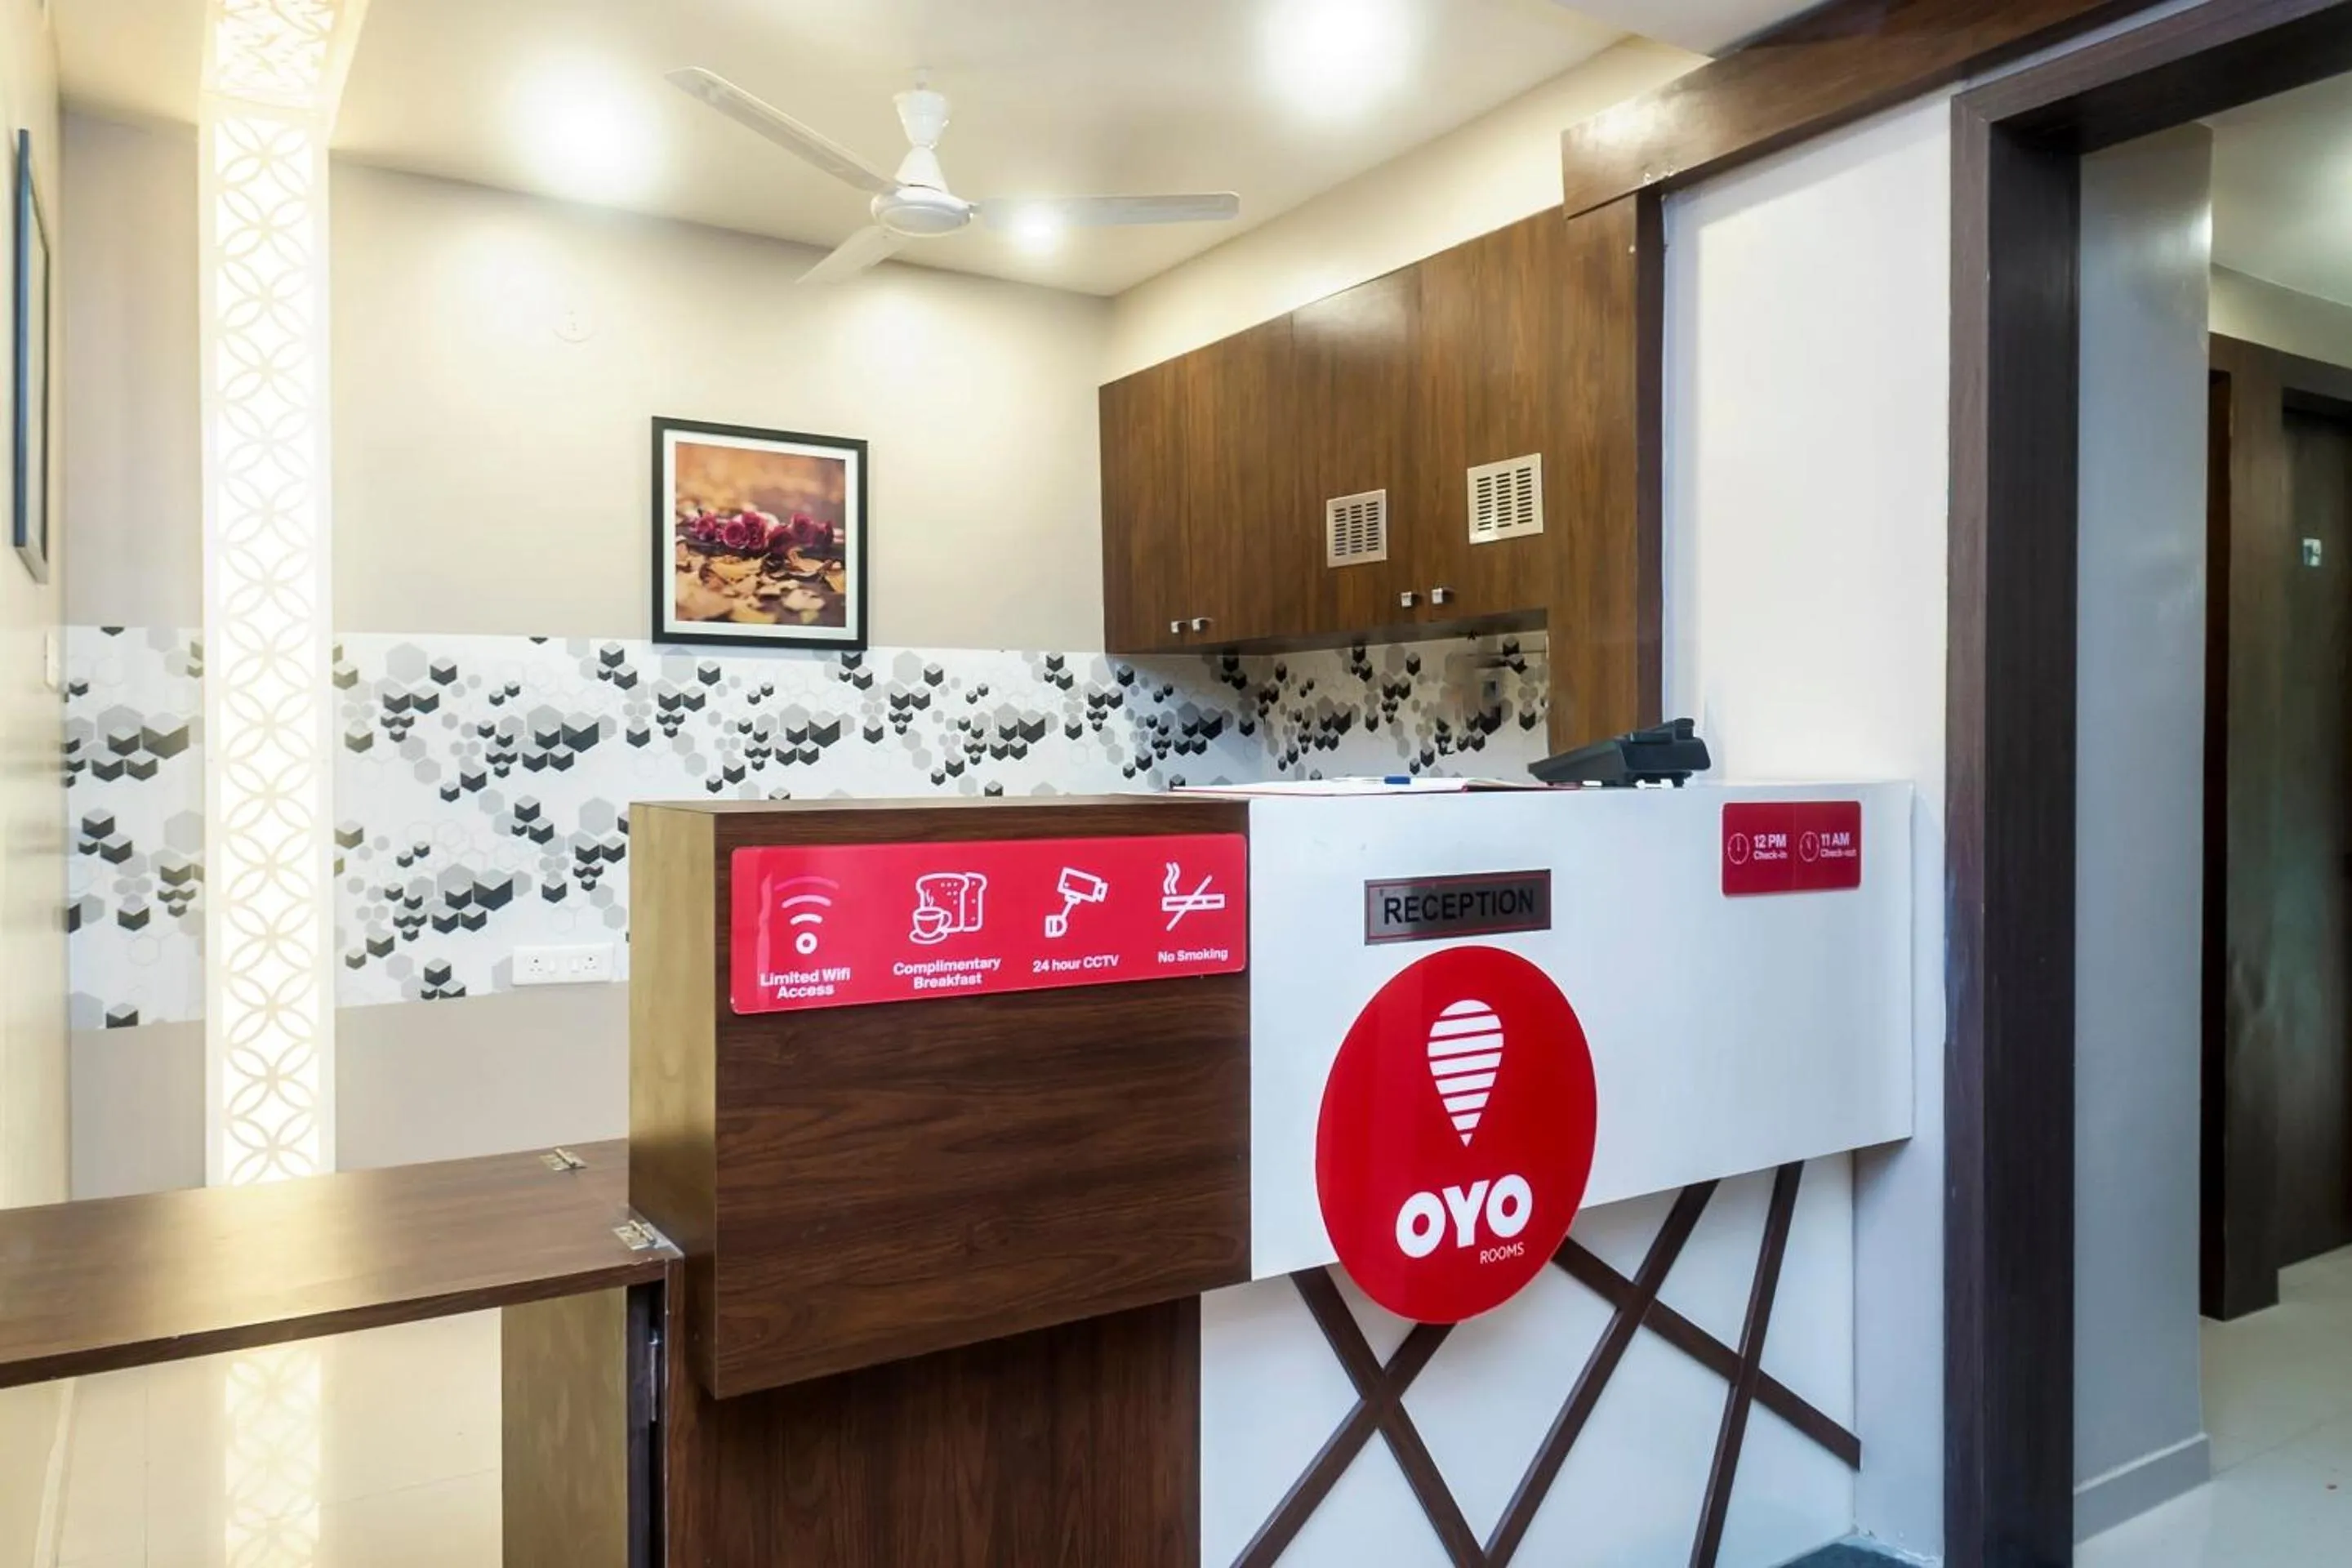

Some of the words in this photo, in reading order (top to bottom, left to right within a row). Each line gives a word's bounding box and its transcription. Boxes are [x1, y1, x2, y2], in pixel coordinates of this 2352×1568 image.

[1753, 835, 1766, 848] 12
[1768, 834, 1787, 848] PM
[1820, 834, 1831, 846] 11
[1832, 832, 1851, 846] AM
[1383, 889, 1535, 924] RECEPTION
[1032, 960, 1050, 973] 24
[1052, 958, 1081, 971] hour
[1083, 954, 1119, 969] CCTV
[1158, 951, 1175, 963] No
[1177, 948, 1228, 962] Smoking
[893, 958, 1001, 976] Complimentary
[760, 969, 820, 987] Limited
[822, 967, 851, 982] Wifi
[914, 972, 982, 990] Breakfast
[777, 985, 835, 999] Access
[1396, 1174, 1533, 1258] OYO
[1480, 1241, 1525, 1265] ROOMS
